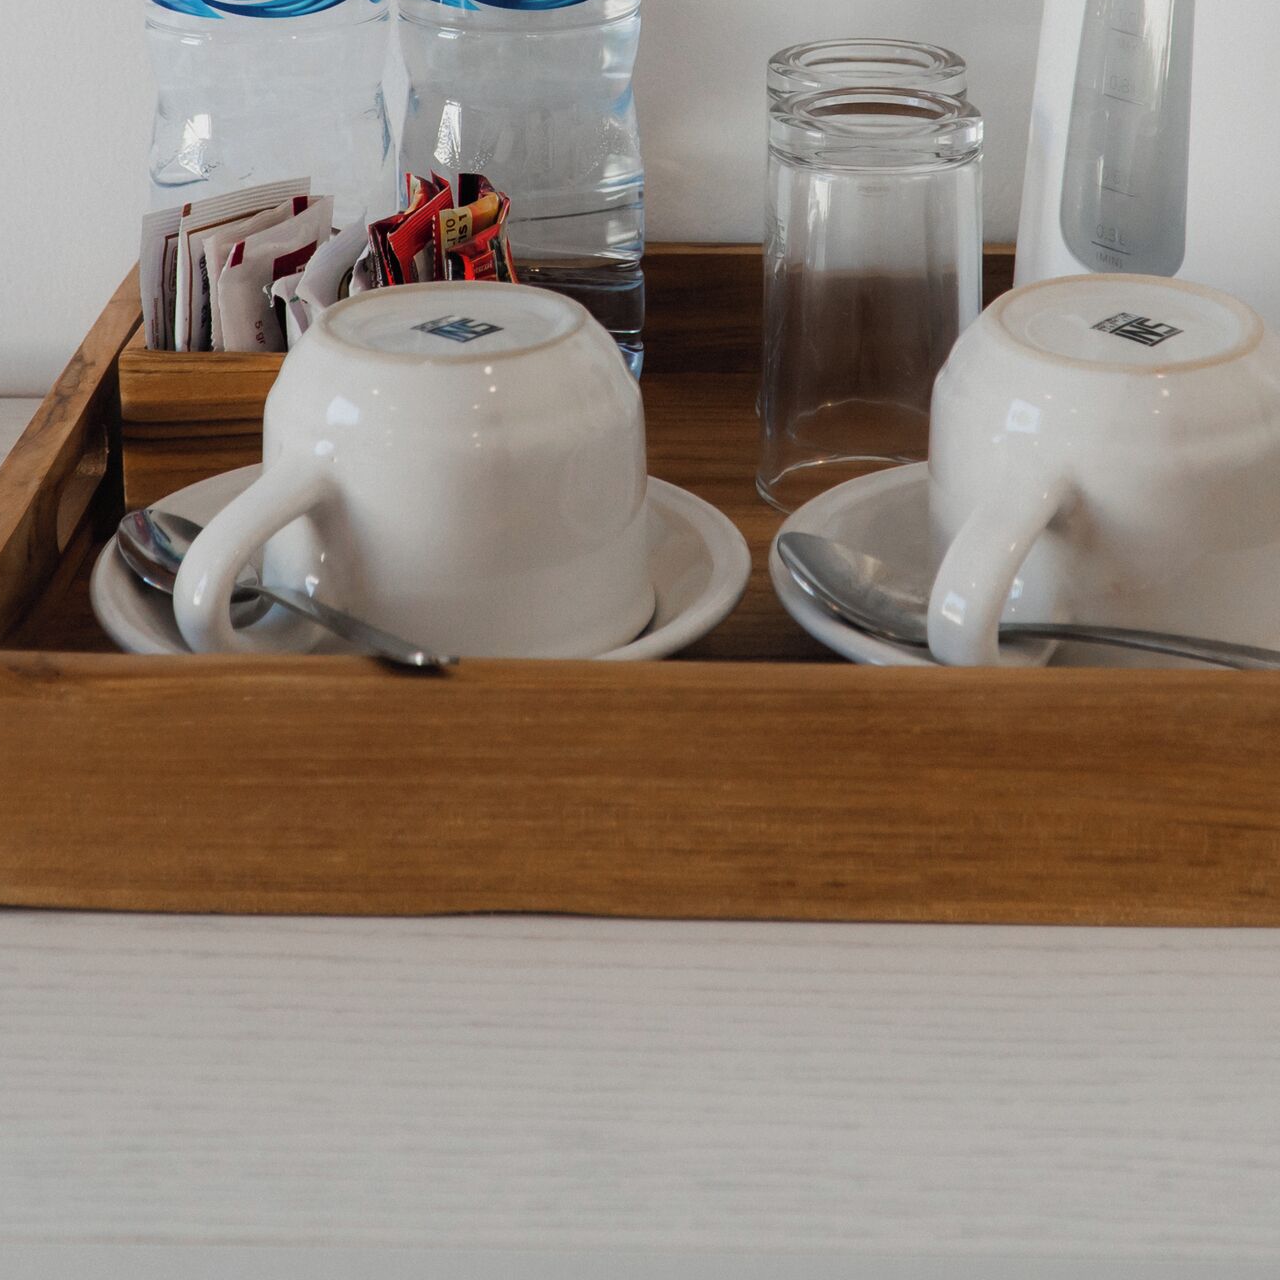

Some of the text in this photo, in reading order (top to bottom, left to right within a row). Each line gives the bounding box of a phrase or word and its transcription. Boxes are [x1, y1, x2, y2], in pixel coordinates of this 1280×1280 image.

[446, 218, 456, 235] 10
[254, 319, 267, 345] 5 gr
